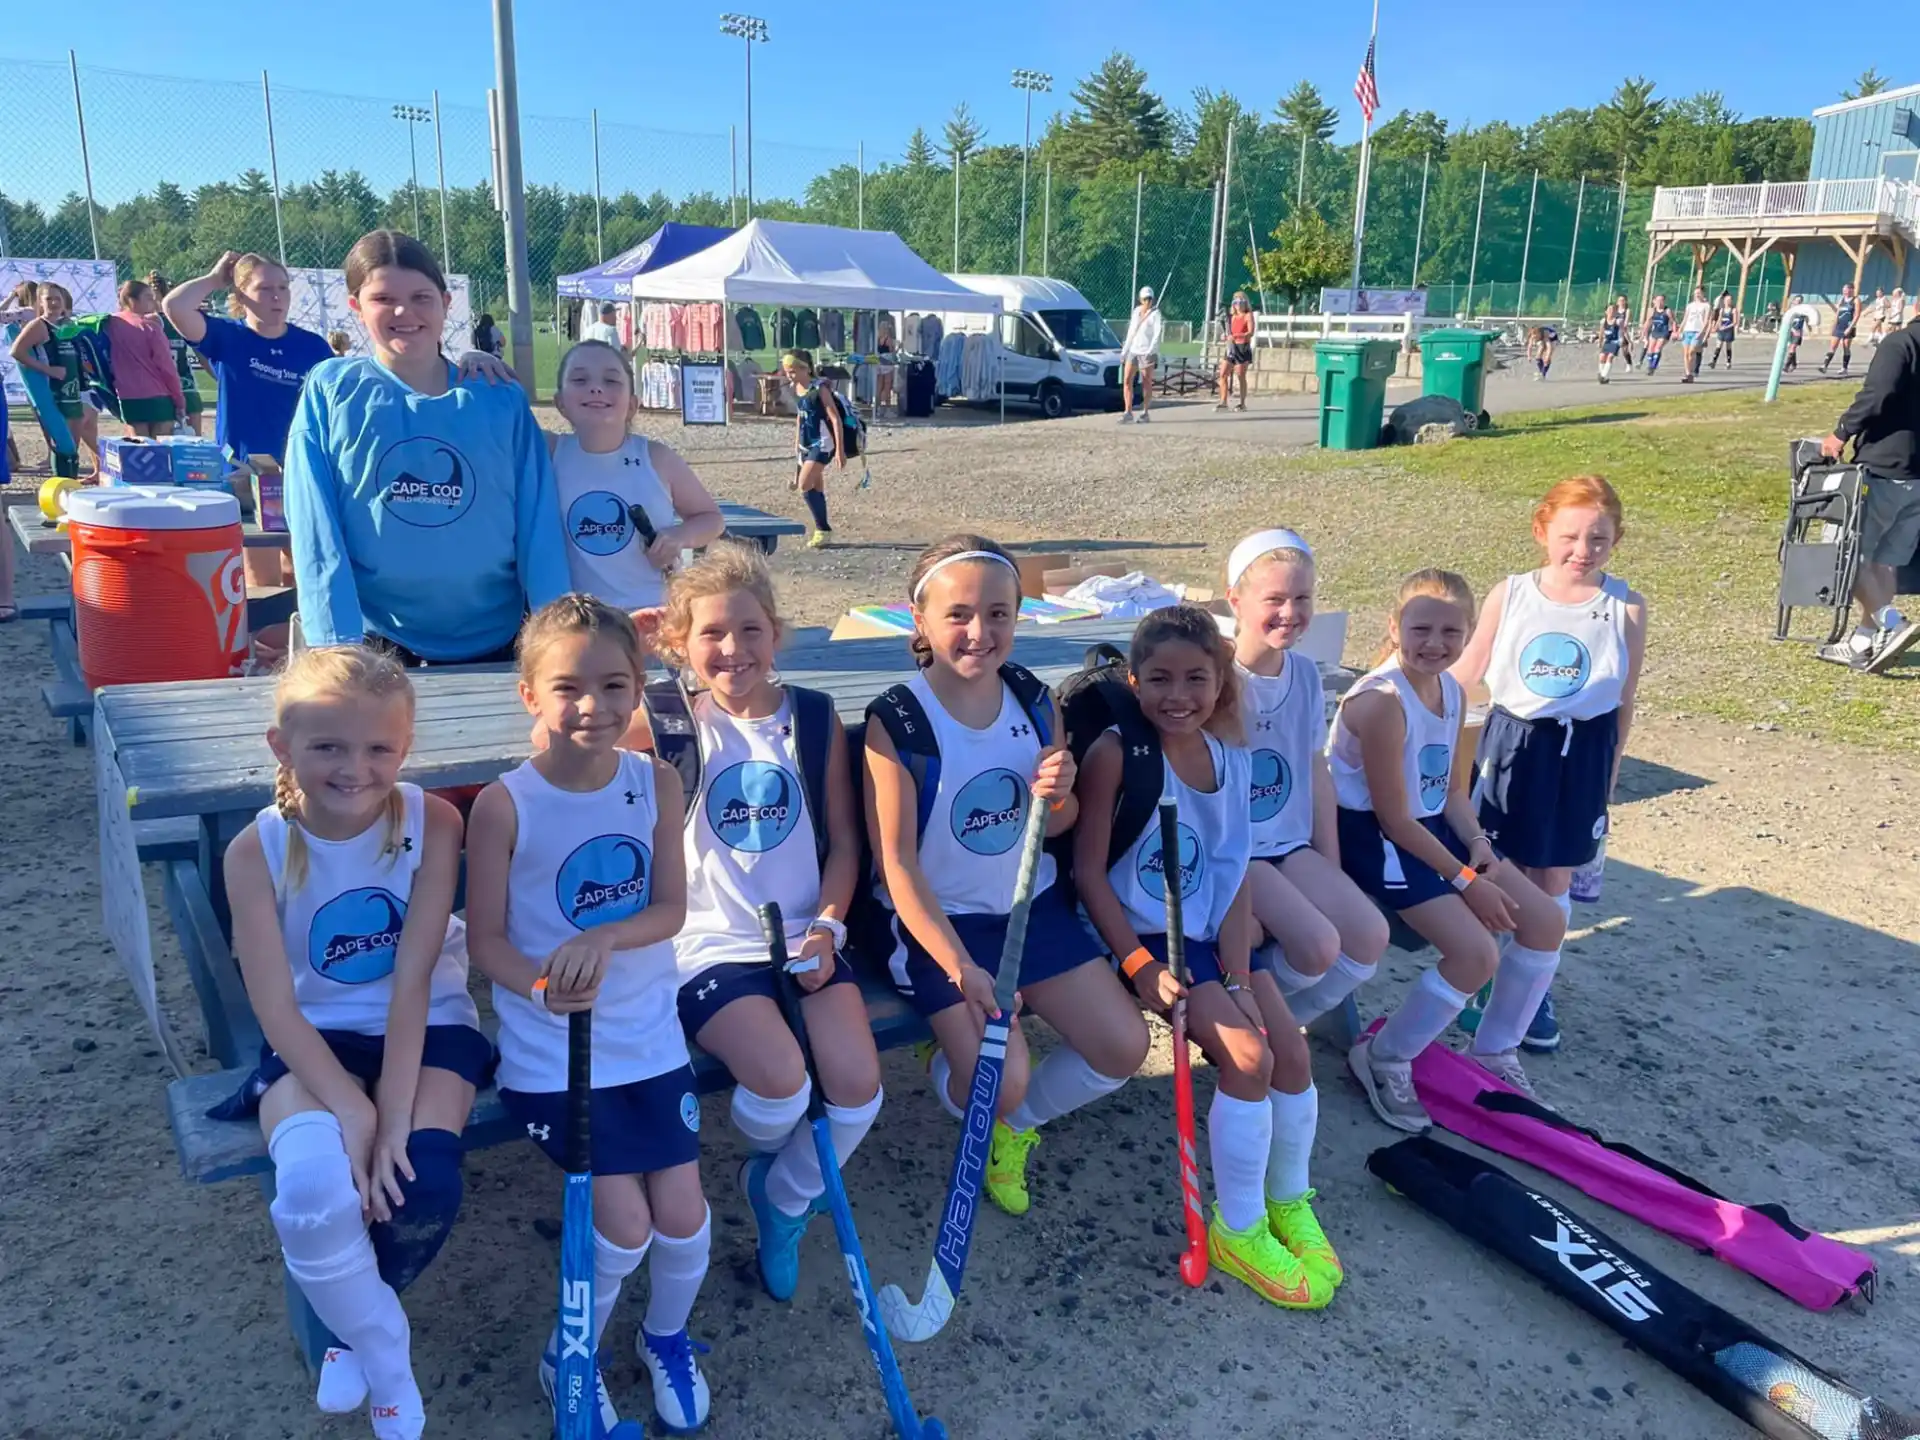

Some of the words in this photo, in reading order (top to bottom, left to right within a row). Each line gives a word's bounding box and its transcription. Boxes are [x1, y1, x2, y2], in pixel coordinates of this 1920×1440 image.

[390, 481, 429, 495] CAPE
[432, 484, 463, 498] COD
[577, 524, 603, 533] CAPE
[604, 524, 625, 533] COD
[1528, 665, 1556, 676] CAPE
[1558, 666, 1581, 677] COD
[720, 807, 757, 821] CAPE
[760, 806, 788, 819] COD
[963, 813, 996, 828] CAPE
[998, 807, 1021, 822] COD
[574, 886, 614, 907] CAPE
[618, 877, 646, 896] COD
[323, 936, 367, 960] CAPE
[938, 1059, 998, 1269] Harrow
[570, 1175, 588, 1184] STX
[1526, 1191, 1598, 1244] HOCKEY
[1529, 1220, 1664, 1321] STX
[1598, 1248, 1652, 1288] FIELD
[562, 1276, 591, 1361] STX
[572, 1375, 582, 1398] RX
[372, 1405, 400, 1418] TCK
